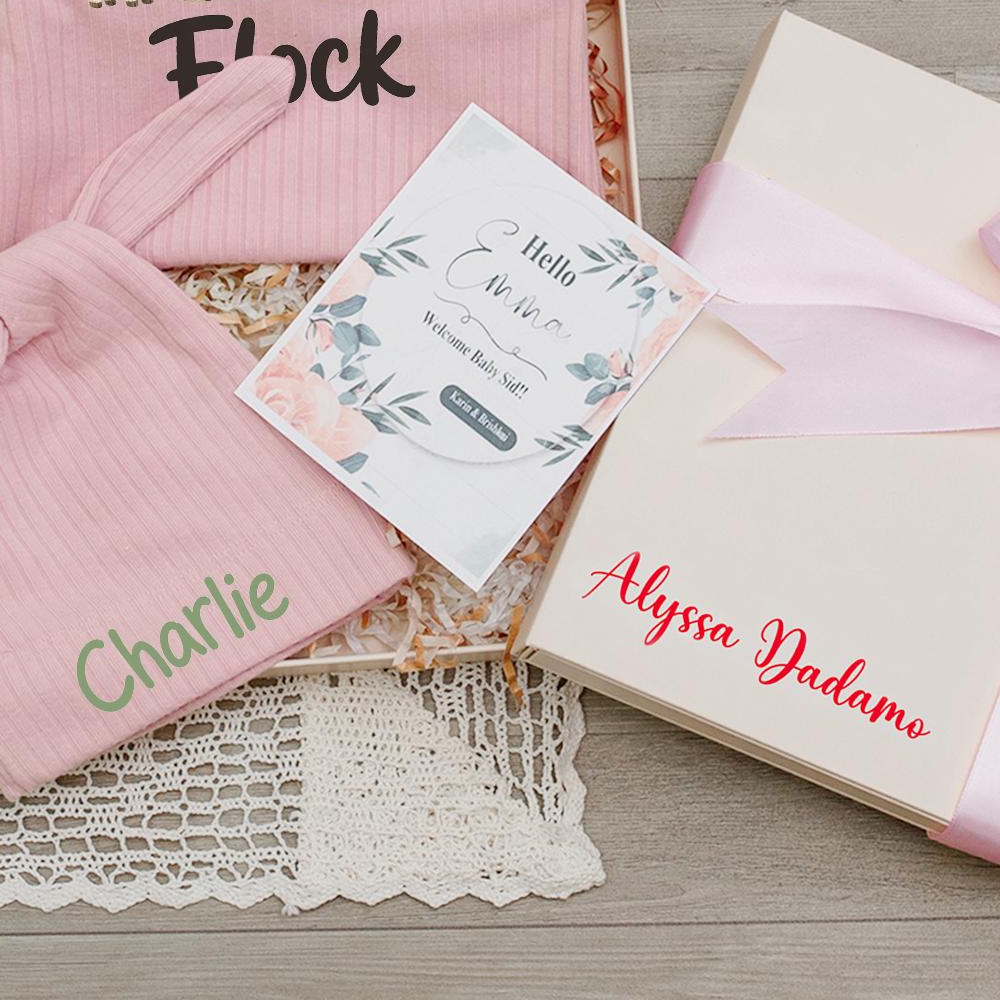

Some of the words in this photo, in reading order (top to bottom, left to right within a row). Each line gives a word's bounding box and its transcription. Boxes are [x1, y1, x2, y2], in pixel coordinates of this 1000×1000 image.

[446, 219, 571, 339] Emma
[521, 234, 576, 287] Hello
[423, 310, 472, 356] Welcome
[470, 349, 499, 380] Baby
[499, 371, 529, 400] Sid!!
[76, 573, 289, 712] Charlie
[581, 550, 740, 646] Alyssa
[754, 618, 931, 739] Dadamo
